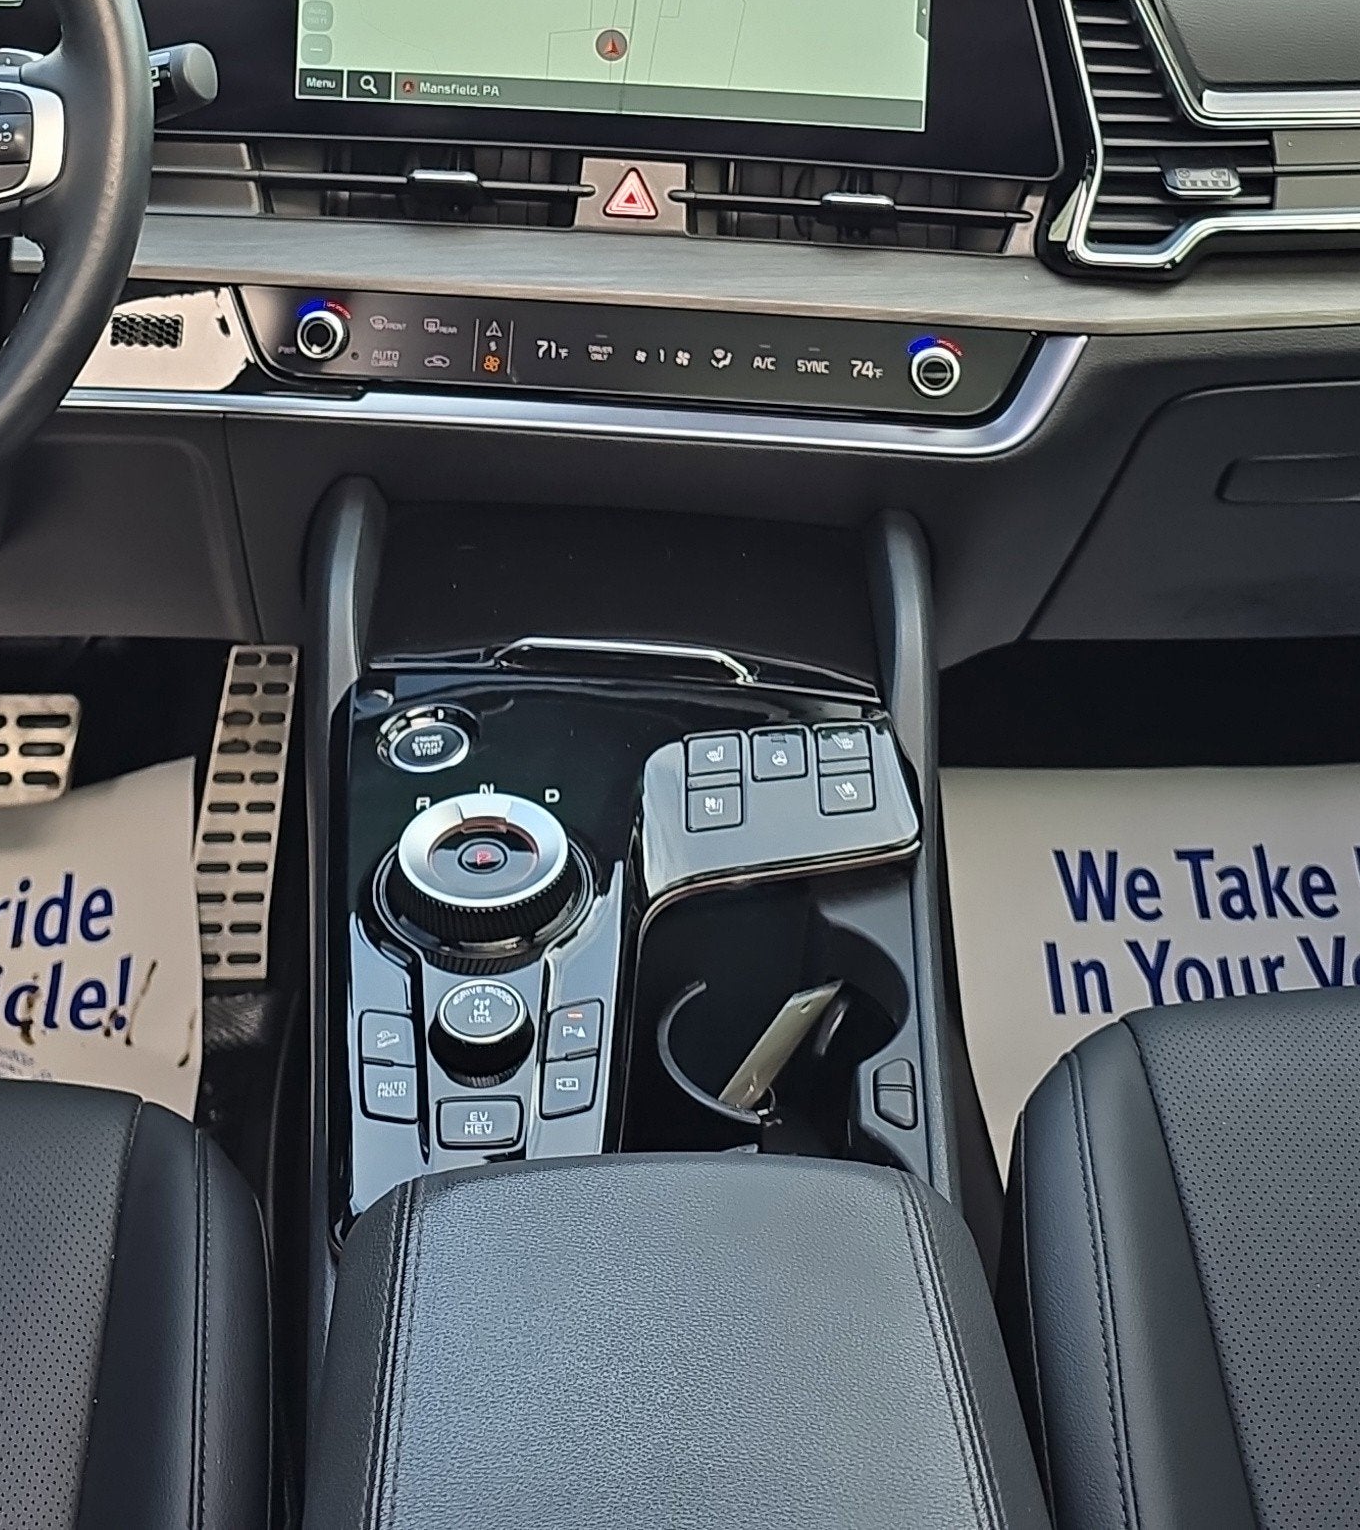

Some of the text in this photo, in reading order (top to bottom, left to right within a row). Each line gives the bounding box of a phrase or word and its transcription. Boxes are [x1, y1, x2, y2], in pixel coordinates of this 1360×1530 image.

[306, 76, 336, 89] Menu
[419, 81, 500, 97] Mansfield, PA
[385, 322, 407, 332] FRONT
[440, 326, 458, 335] REAR
[372, 350, 400, 361] AUTO
[753, 356, 776, 371] A/C
[796, 359, 829, 374] SYNC
[479, 783, 495, 795] N
[544, 789, 560, 803] D
[1051, 848, 1164, 923] We
[1173, 843, 1340, 921] Take
[1043, 940, 1114, 1015] In
[1125, 938, 1287, 1007] Your
[468, 1015, 493, 1024] LOCK
[377, 1081, 407, 1090] AUTO
[377, 1088, 407, 1098] HOLD
[469, 1111, 489, 1122] EV
[464, 1122, 493, 1135] HEV
